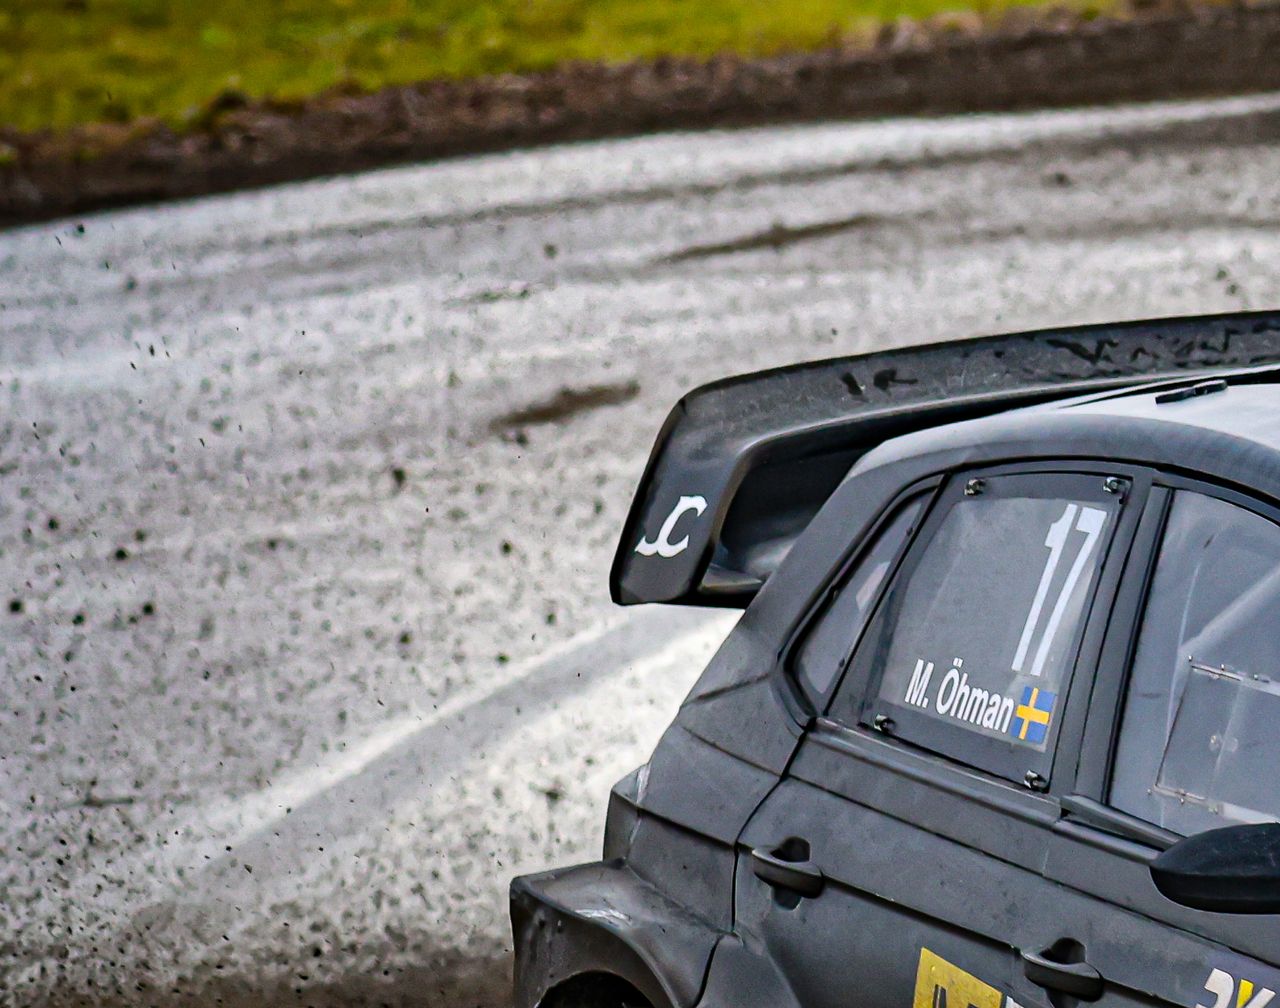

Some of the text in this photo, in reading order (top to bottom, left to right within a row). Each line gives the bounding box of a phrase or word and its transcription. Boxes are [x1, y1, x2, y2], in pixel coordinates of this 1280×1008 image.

[1011, 503, 1107, 677] 17
[904, 657, 1015, 734] M. Öhman
